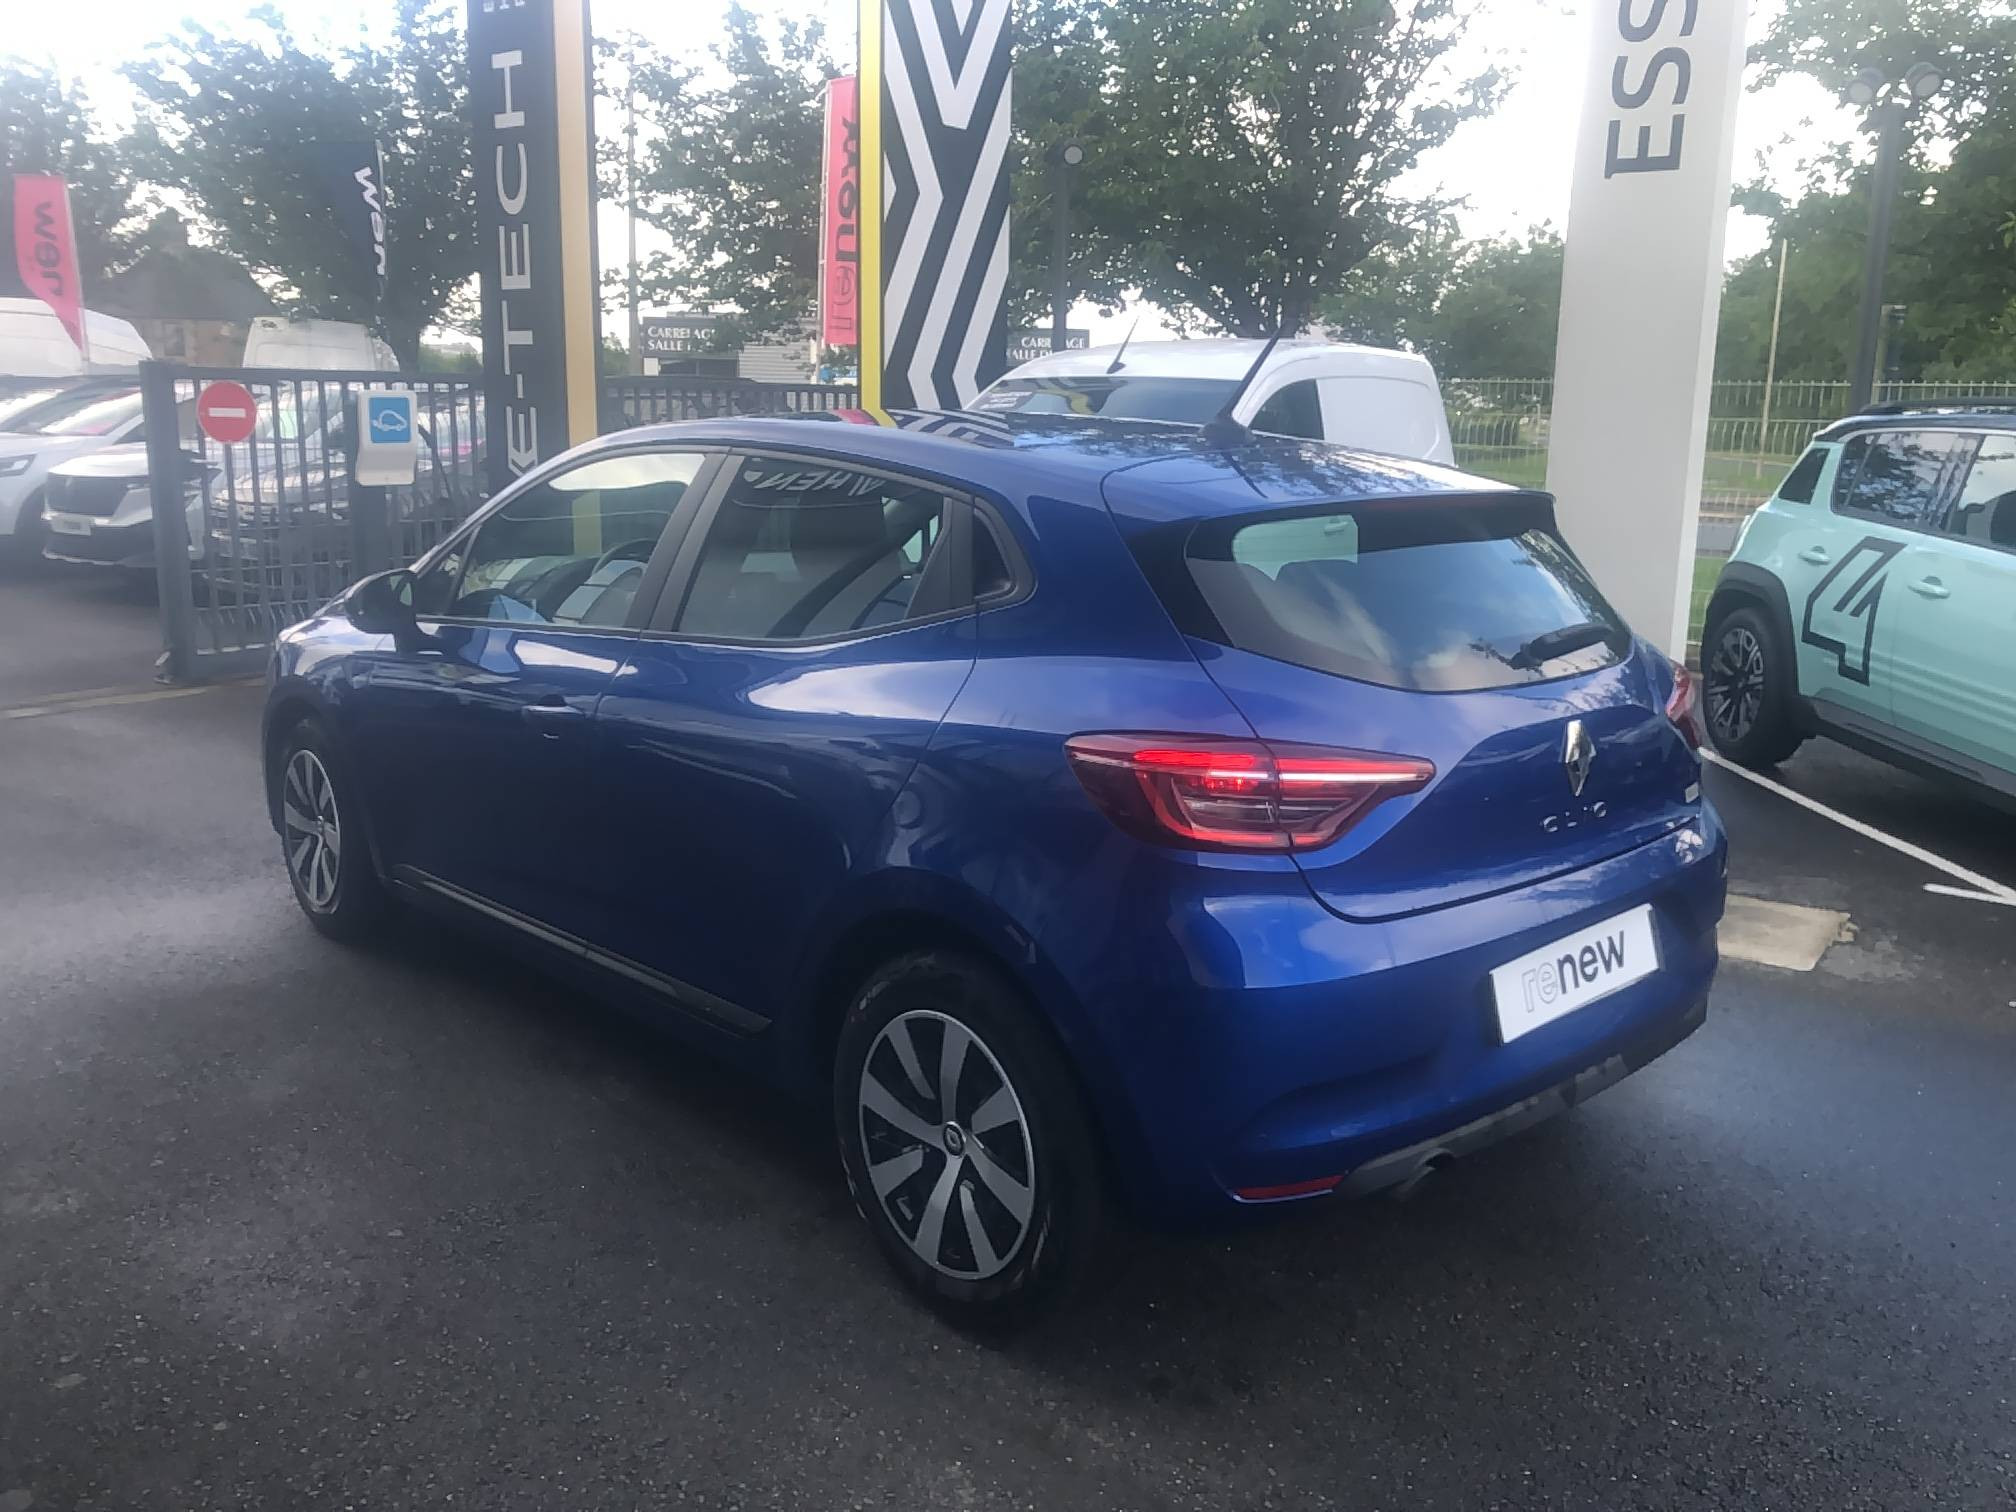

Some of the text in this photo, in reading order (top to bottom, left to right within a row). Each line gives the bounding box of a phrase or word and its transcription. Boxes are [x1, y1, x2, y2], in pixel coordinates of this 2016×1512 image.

[1604, 0, 1699, 179] ESS
[647, 326, 716, 340] CARRELAG
[1542, 801, 1607, 833] CLO
[1521, 930, 1624, 1014] renew
